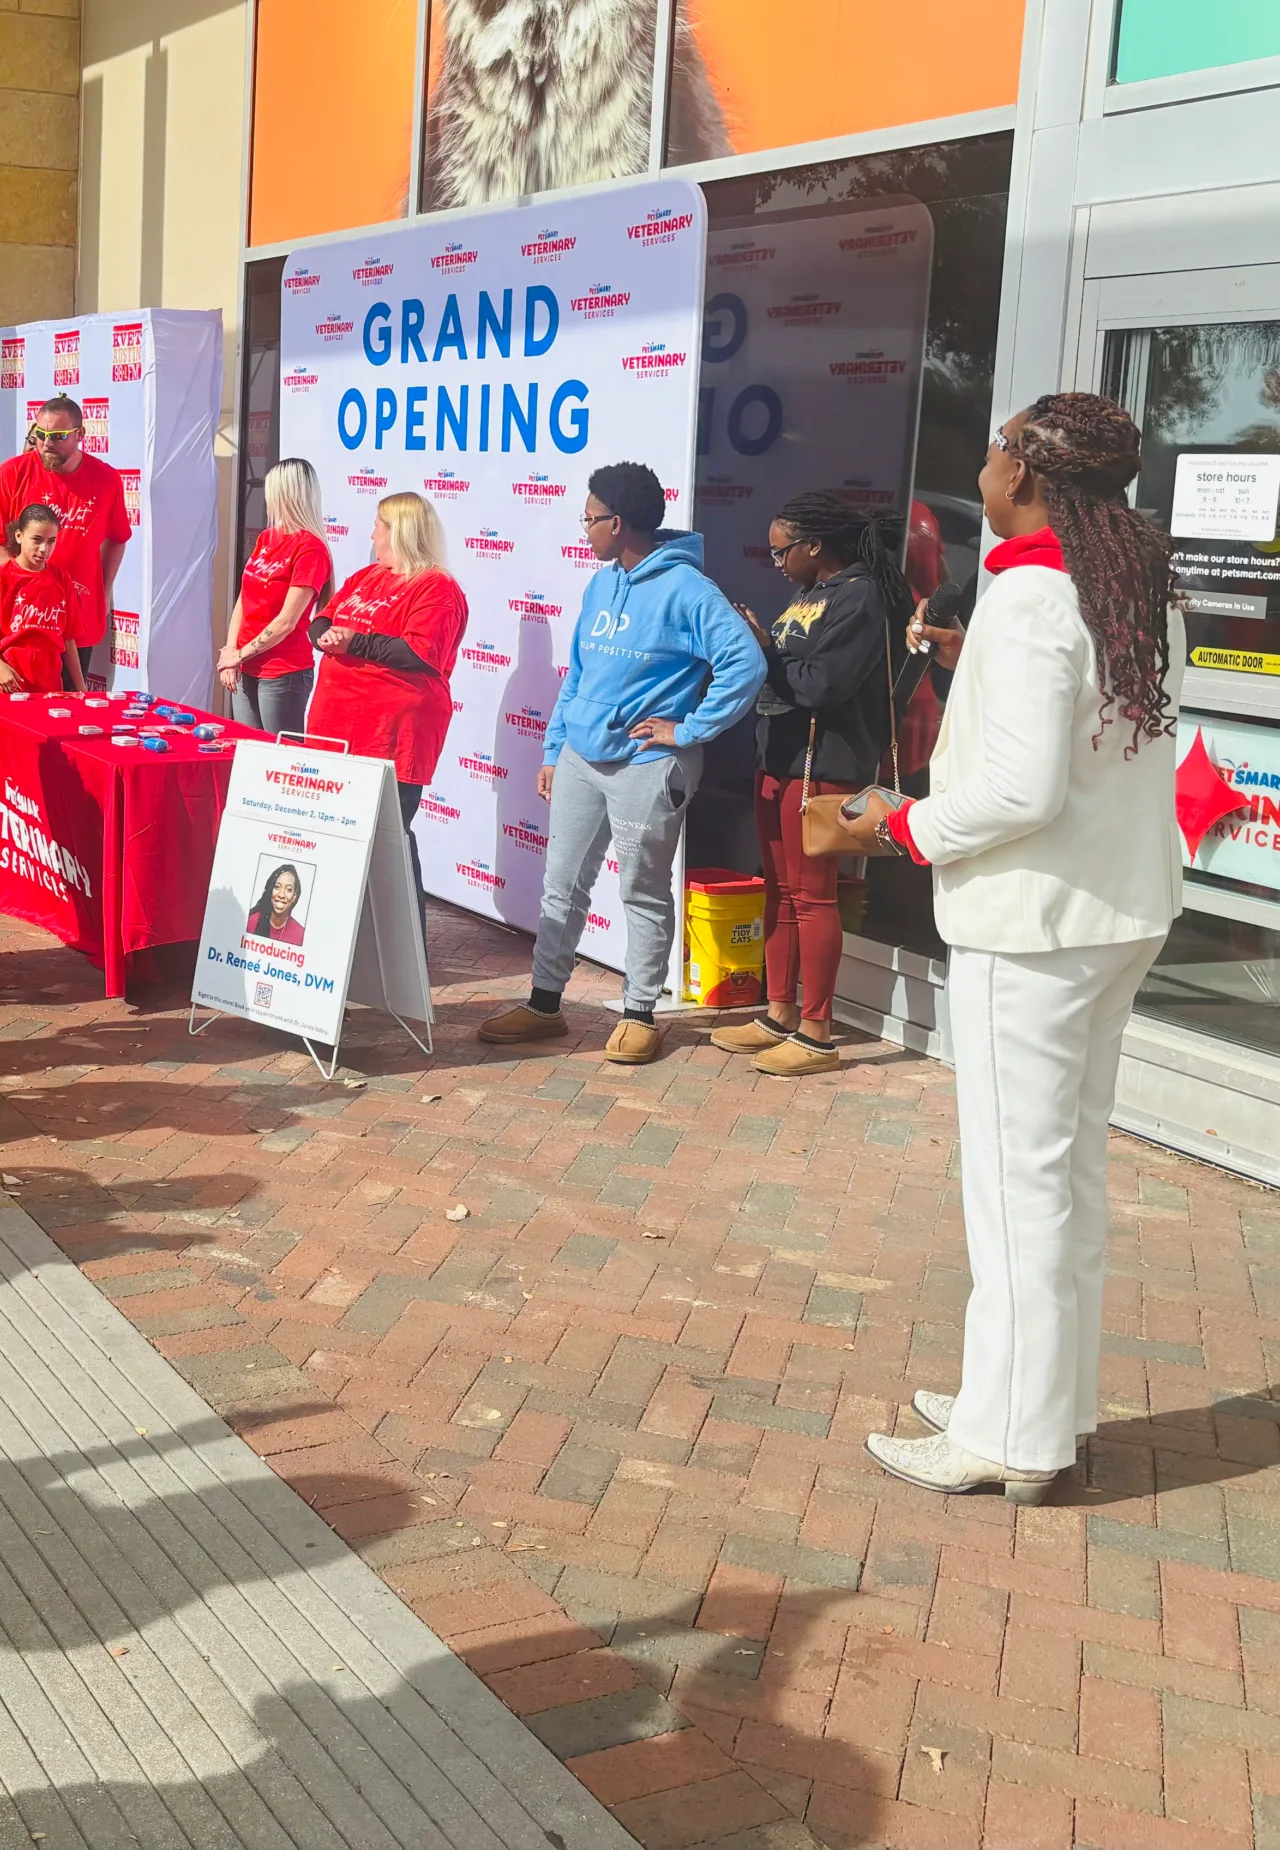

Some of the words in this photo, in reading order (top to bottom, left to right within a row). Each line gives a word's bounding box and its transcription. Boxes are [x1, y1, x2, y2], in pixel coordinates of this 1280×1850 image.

[647, 210, 671, 220] PETSMART
[627, 214, 693, 239] VETERINARY
[521, 237, 576, 257] VETERINARY
[642, 234, 675, 247] SERVICES
[431, 251, 478, 268] VETERINARY
[533, 254, 561, 264] SERVICES
[352, 264, 394, 280] VETERINARY
[442, 266, 465, 275] SERVICES
[284, 274, 320, 287] VETERINARY
[362, 278, 382, 286] SERVICES
[589, 285, 611, 294] PETSMART
[571, 292, 630, 311] VETERINARY
[584, 309, 614, 319] SERVICES
[316, 321, 354, 334] VETERINARY
[363, 285, 560, 366] GRAND
[54, 337, 79, 354] KVET
[113, 330, 142, 347] KVET
[2, 345, 24, 358] KVET
[642, 344, 665, 353] PETSMART
[622, 353, 686, 370] VETERINARY
[283, 374, 318, 385] VETERINARY
[637, 368, 668, 378] SERVICES
[82, 405, 109, 419] KVET
[338, 380, 589, 454] OPENING
[82, 420, 108, 435] USTIN
[122, 477, 140, 491] ET
[348, 476, 387, 486] VETERINARY
[1197, 472, 1223, 482] store
[1226, 472, 1256, 482] hours
[424, 479, 470, 492] VETERINARY
[512, 483, 566, 497] VETERINARY
[525, 497, 552, 505] SERVICES
[324, 524, 349, 536] RINARY
[465, 538, 514, 552] VETERINARY
[476, 551, 502, 560] SERVICES
[561, 546, 596, 560] VETERI
[1186, 553, 1208, 562] make
[1227, 555, 1248, 564] store
[1251, 556, 1280, 567] hours?
[574, 560, 604, 569] SERVICES
[1176, 566, 1209, 576] anytime
[1211, 568, 1220, 576] at
[509, 600, 562, 617] VETERINARY
[1202, 599, 1232, 609] Cameras
[111, 617, 139, 634] KVET
[521, 614, 548, 624] SERVICES
[462, 648, 510, 667] VETERINARY
[1198, 651, 1240, 666] AUTOMATIC
[1242, 655, 1263, 668] DOOR
[473, 662, 497, 673] SERVICES
[506, 713, 546, 732] VETERINA
[518, 728, 545, 740] SERVICES
[291, 765, 319, 775] PETSMART
[458, 756, 508, 779] VETERINARY
[266, 770, 344, 794] VETERINARY
[281, 787, 320, 800] SERVICES
[242, 798, 273, 811] Saturday,
[275, 804, 308, 816] December
[318, 812, 335, 822] 12pm
[341, 815, 356, 826] 2pm
[420, 799, 460, 819] ETERINARY
[268, 833, 316, 850] VETERINARY
[515, 840, 542, 854] SERVICES
[456, 863, 506, 888] VETERINARY
[240, 935, 305, 968] Introducing
[208, 947, 223, 964] Dr.
[226, 952, 260, 974] Reneé
[263, 963, 301, 988] Jones,
[305, 974, 334, 993] DVM
[235, 1002, 245, 1010] Book
